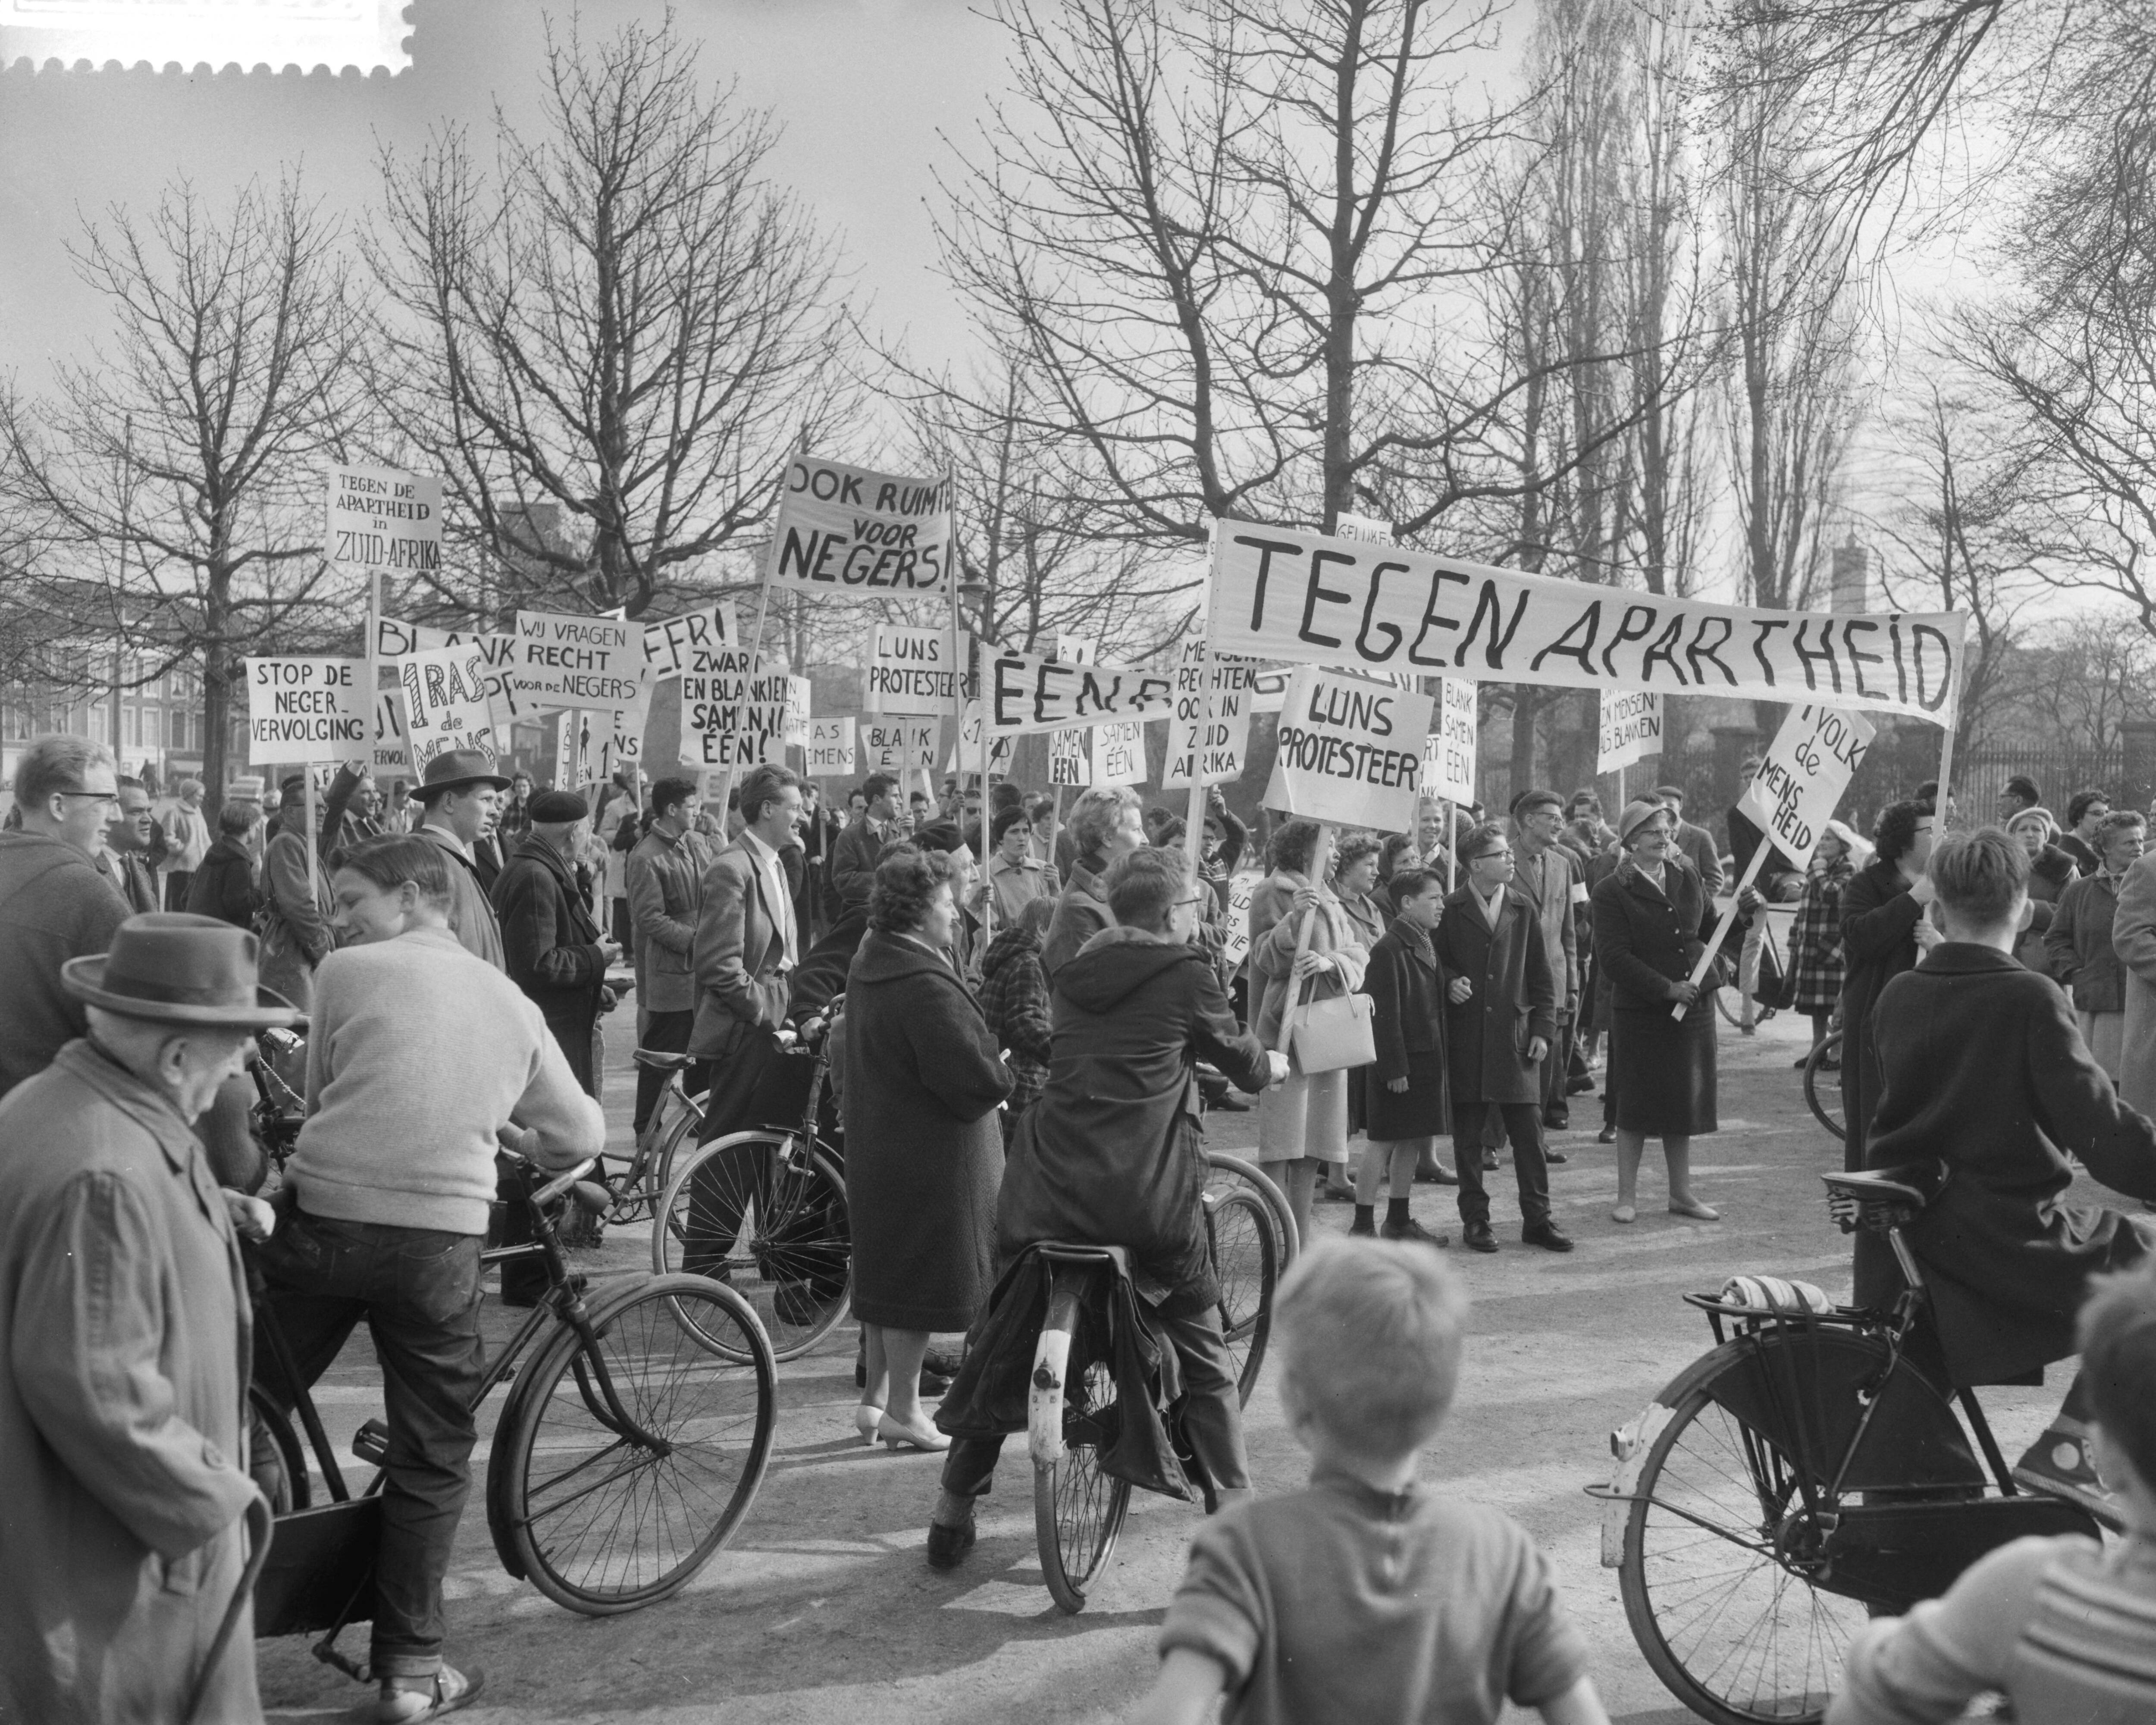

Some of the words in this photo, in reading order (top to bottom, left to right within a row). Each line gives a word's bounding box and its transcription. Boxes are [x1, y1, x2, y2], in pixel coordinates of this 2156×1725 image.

[339, 474, 387, 495] TEGEN
[394, 482, 415, 499] DE
[790, 463, 862, 505] OOK
[336, 494, 430, 520] APARTHEID
[373, 517, 388, 529] in
[854, 519, 918, 548] VOOR
[334, 530, 442, 569] ZUID-AFRIKA
[779, 527, 950, 593] NEGERS!
[520, 619, 545, 638] WIJ
[555, 623, 625, 647] VRAGEN
[1233, 535, 1531, 670] TEGEN
[1530, 598, 1952, 712] APARTHEID
[527, 644, 611, 670] RECHT
[878, 636, 939, 661] LUNS
[257, 663, 313, 685] STOP
[324, 665, 352, 686] DE
[513, 679, 542, 691] VOOR
[545, 683, 560, 693] DE
[684, 678, 705, 700] EN
[870, 666, 968, 698] PROTESTEER
[403, 663, 429, 729] 1
[425, 655, 485, 708] RAS
[1446, 682, 1473, 714] BLANK
[441, 711, 463, 731] de
[1178, 696, 1213, 721] OO
[1221, 695, 1238, 717] IN
[1308, 682, 1395, 736] LUNS
[252, 718, 364, 741] VERVOLGING
[809, 725, 840, 739] AS
[1051, 729, 1087, 760] SAMEN
[1100, 721, 1140, 747] SAMEN
[1445, 714, 1473, 746] SAMEN
[1614, 716, 1660, 749] BLANKEN
[1816, 706, 1867, 772] VOLK
[702, 727, 768, 764] ÉÉN!
[881, 748, 934, 765] ÉN
[1106, 745, 1134, 777] ÉÉN
[1279, 726, 1419, 792] PROTESTEER
[1795, 735, 1820, 776] de
[1756, 756, 1804, 811] MENS
[1771, 801, 1811, 850] HEID
